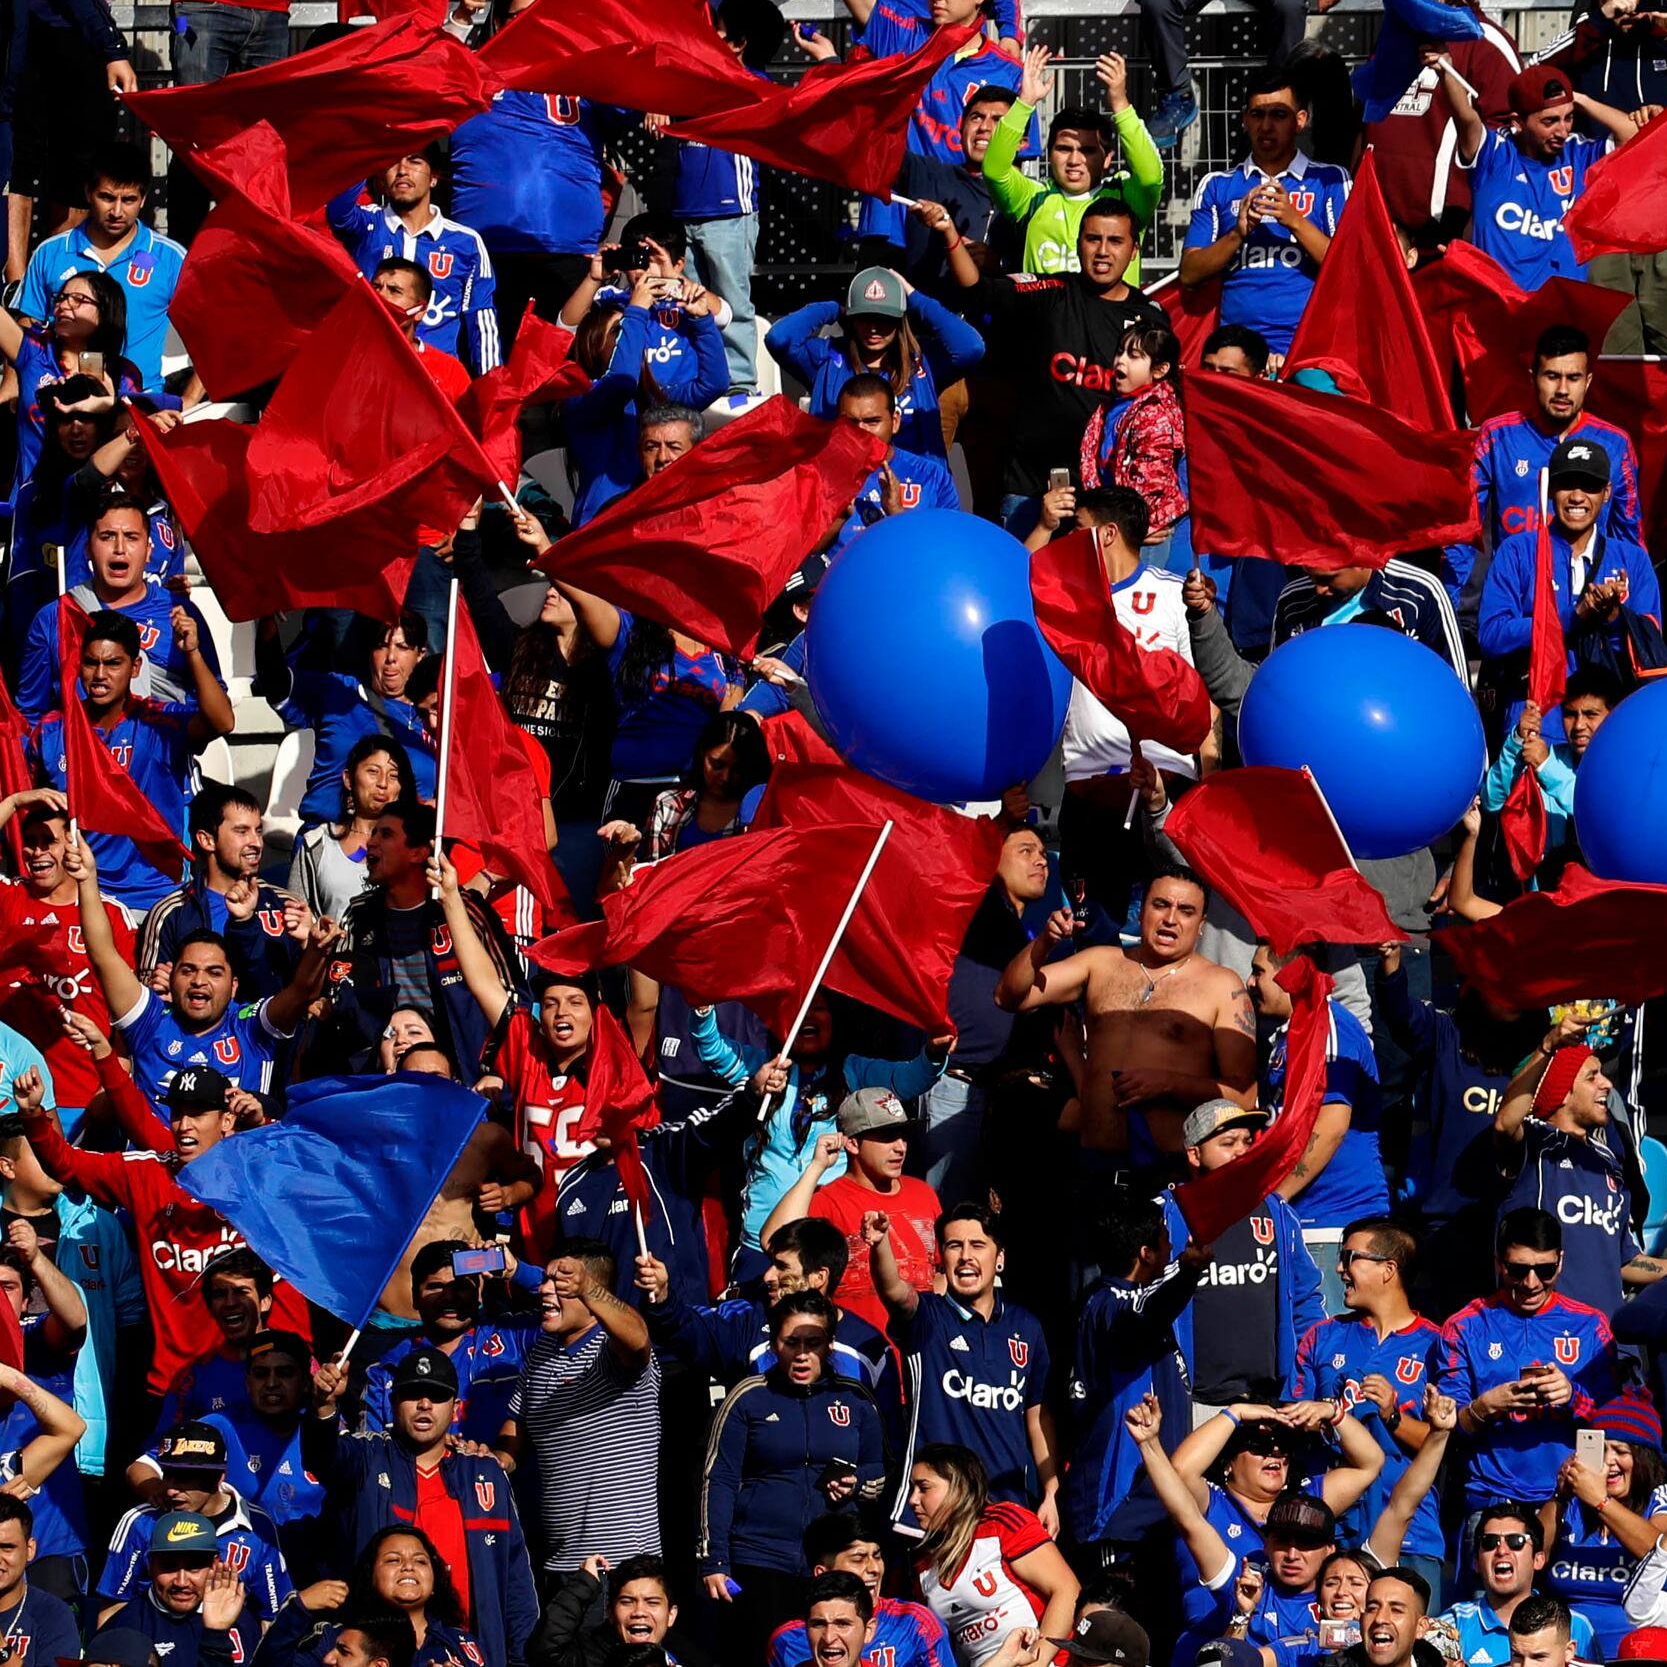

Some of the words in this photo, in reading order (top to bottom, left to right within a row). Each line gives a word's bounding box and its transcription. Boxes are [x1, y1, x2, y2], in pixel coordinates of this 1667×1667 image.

[1548, 166, 1575, 196] U
[428, 251, 454, 279] U
[1037, 240, 1082, 272] Cla
[1050, 351, 1116, 393] Clar
[257, 910, 285, 938] U
[213, 1035, 241, 1064] U
[179, 1071, 198, 1092] NY
[1251, 1216, 1274, 1245] U
[1008, 1338, 1029, 1368] U
[1553, 1337, 1580, 1365] U
[1396, 1357, 1424, 1384] U
[943, 1369, 1021, 1411] Claro
[171, 1437, 216, 1456] LAKERS
[174, 1520, 199, 1534] NIKE
[972, 1570, 997, 1598] U
[1550, 1559, 1630, 1583] Claro
[264, 1563, 278, 1615] TRAMONTINA
